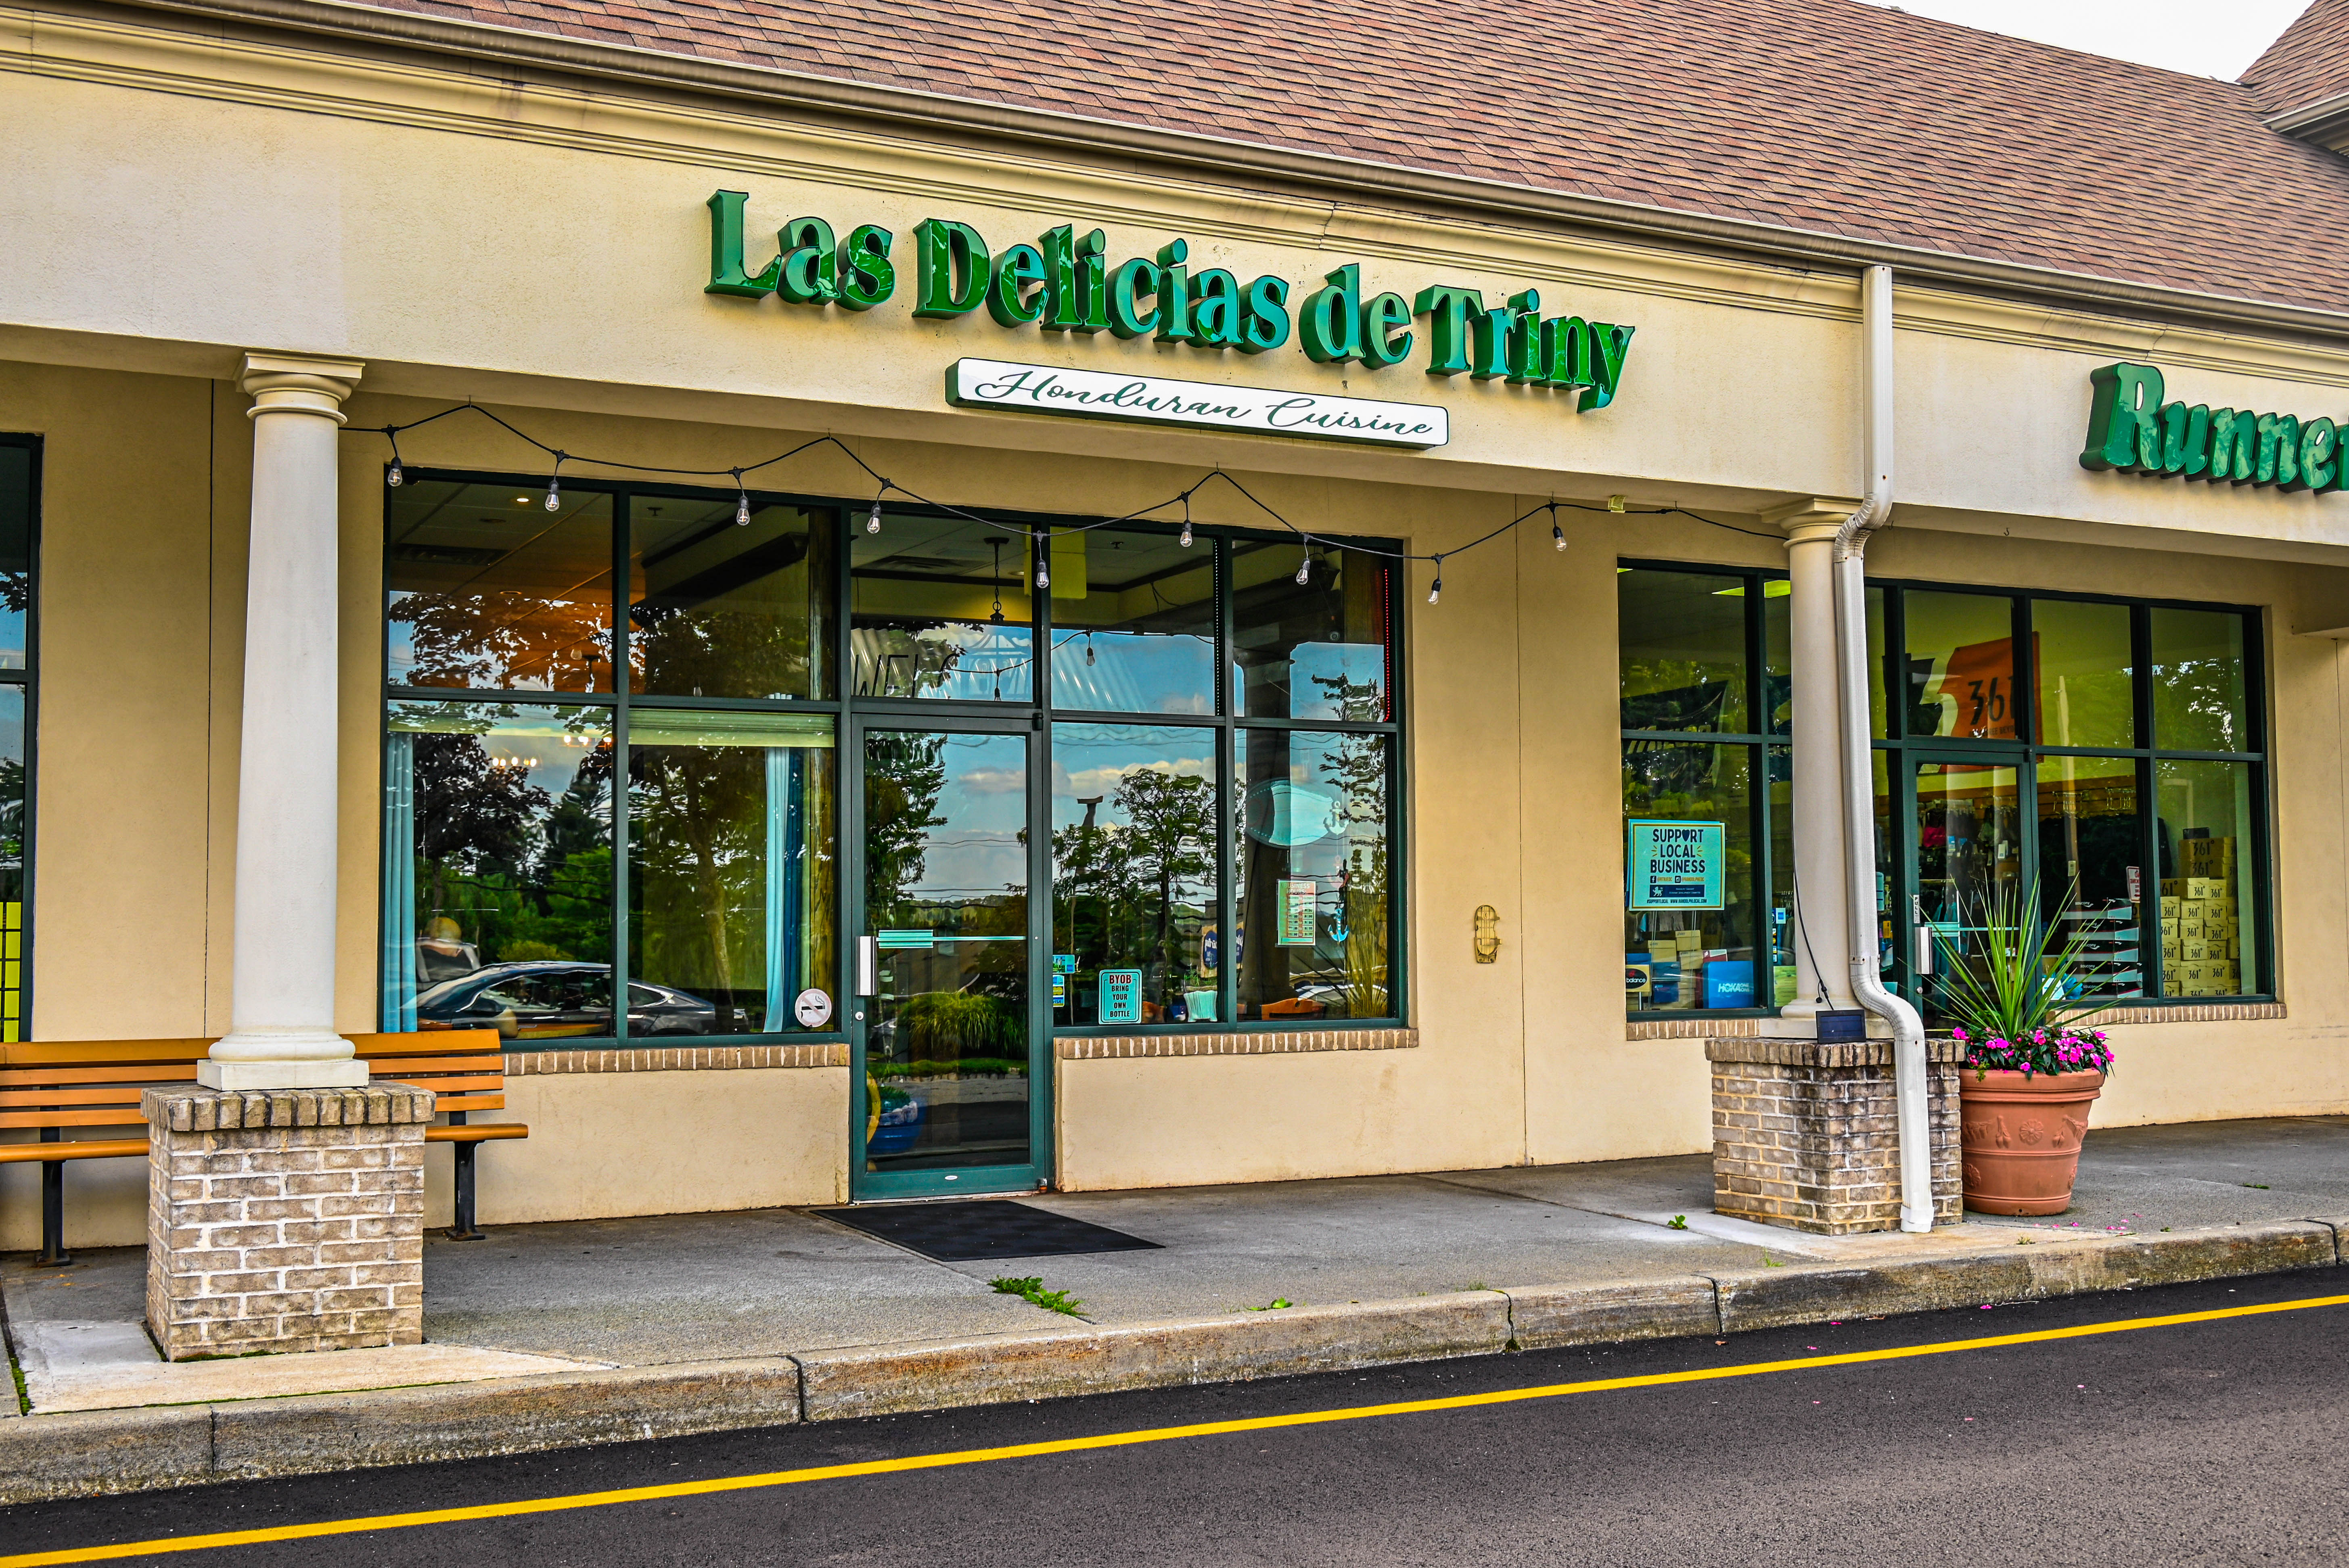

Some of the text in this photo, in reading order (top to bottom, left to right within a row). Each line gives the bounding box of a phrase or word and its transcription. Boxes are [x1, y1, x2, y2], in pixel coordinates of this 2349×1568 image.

[704, 188, 1636, 414] Las Delicias de Triny
[975, 370, 1434, 435] Honduran Cuisine
[1652, 828, 1704, 843] SUPPORT
[1660, 844, 1696, 858] LOCAL
[1650, 859, 1705, 873] BUSINESS
[1109, 975, 1132, 984] BYOB
[1717, 983, 1740, 992] HOKA
